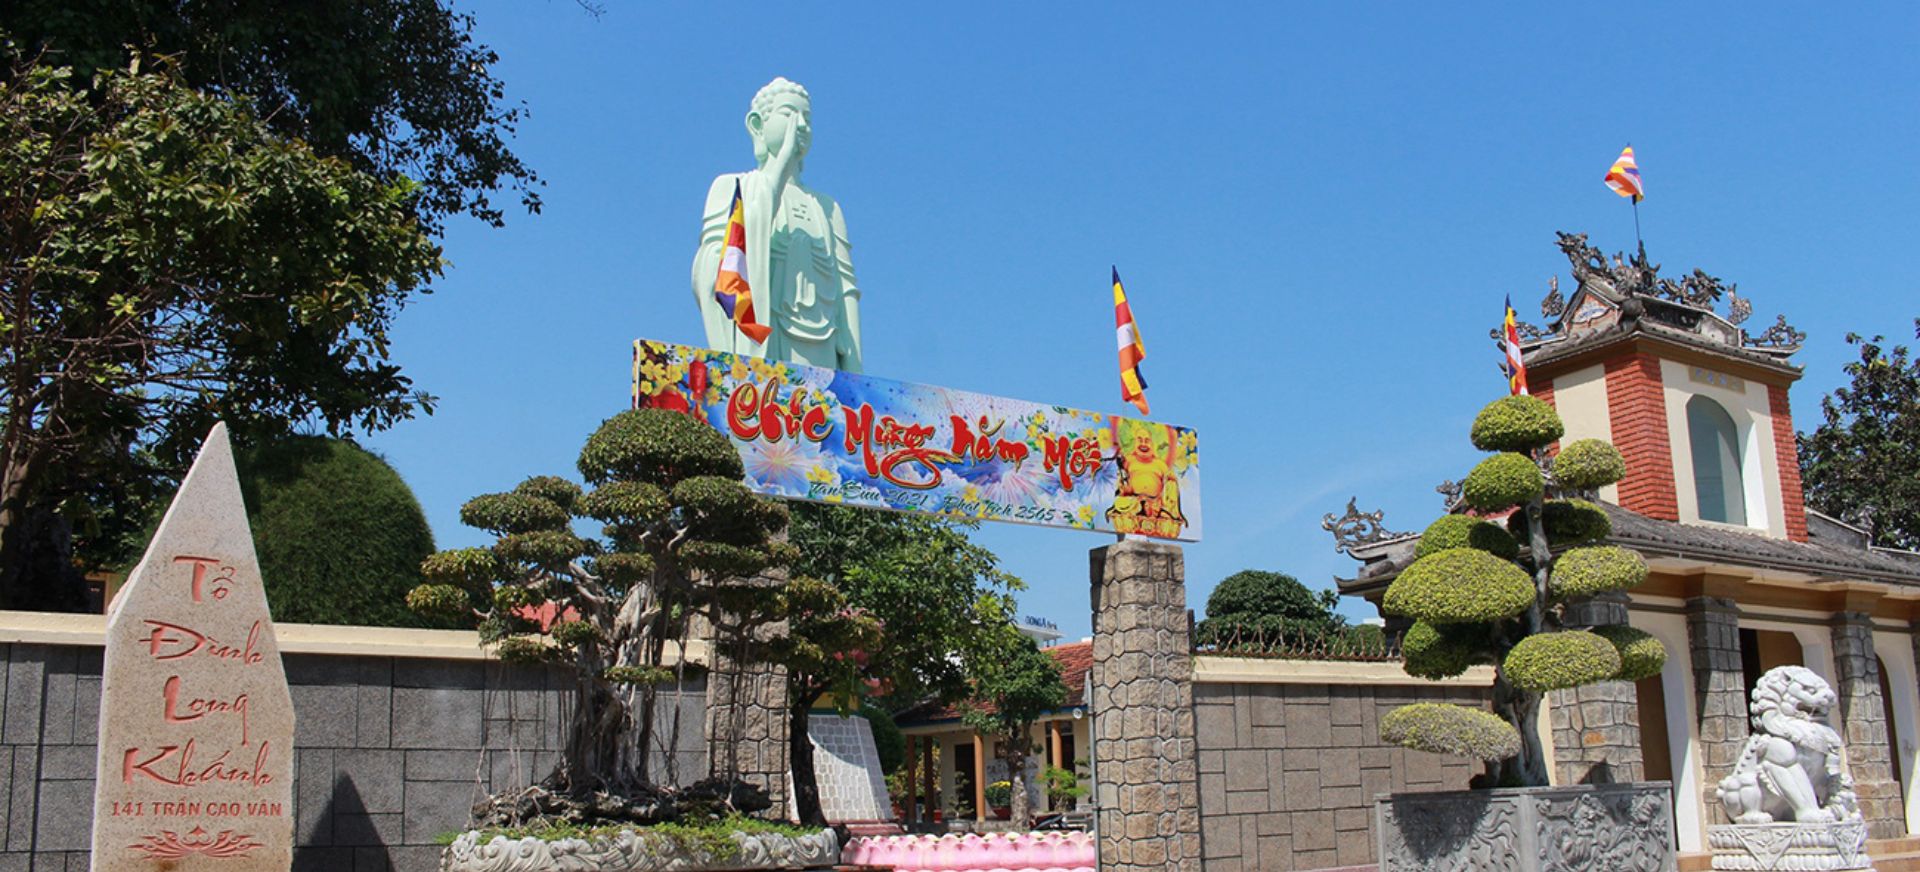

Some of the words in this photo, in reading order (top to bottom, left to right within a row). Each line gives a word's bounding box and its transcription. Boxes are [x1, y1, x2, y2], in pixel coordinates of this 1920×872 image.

[884, 488, 929, 506] 2021
[1014, 506, 1057, 521] 2565
[173, 555, 236, 603] Tổ
[138, 619, 264, 666] Đình
[163, 675, 249, 747] Long
[123, 737, 273, 788] Khánh
[111, 801, 144, 816] 141
[206, 802, 241, 817] CAO
